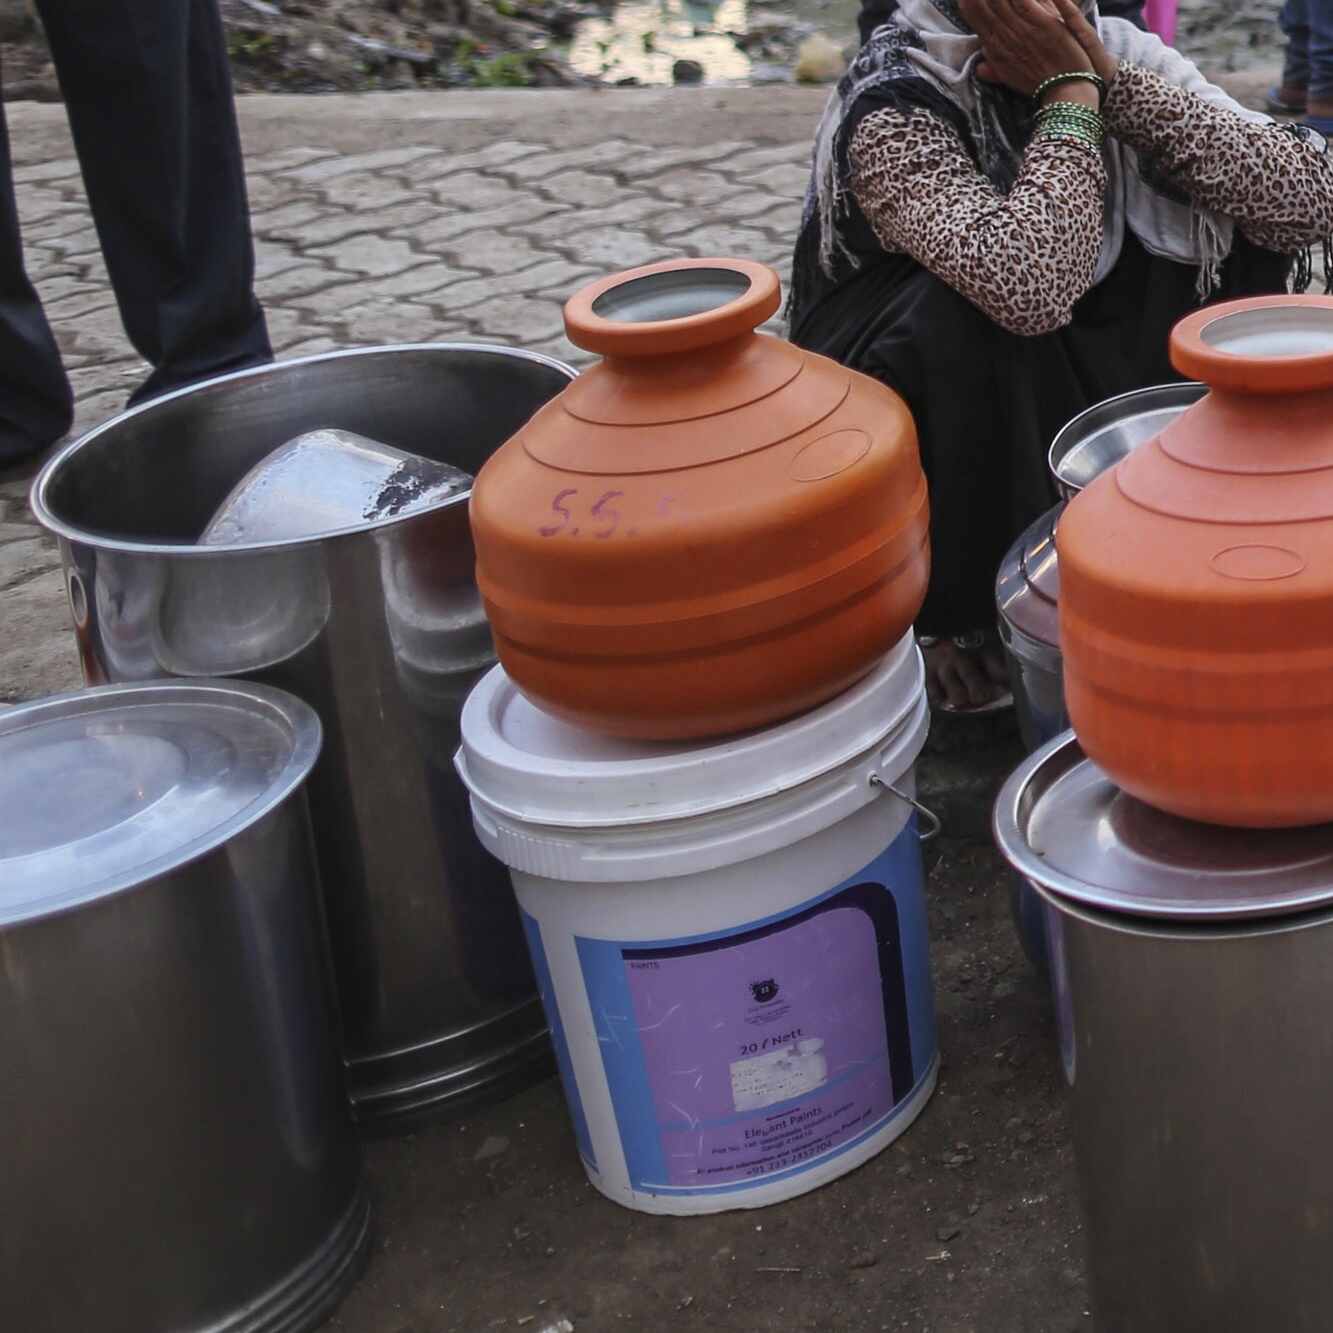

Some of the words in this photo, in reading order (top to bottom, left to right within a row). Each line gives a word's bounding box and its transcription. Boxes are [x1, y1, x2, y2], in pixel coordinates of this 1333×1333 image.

[630, 961, 660, 971] PAINTS
[740, 1043, 758, 1056] 20
[772, 1028, 804, 1046] Nett
[790, 1106, 823, 1126] Paints
